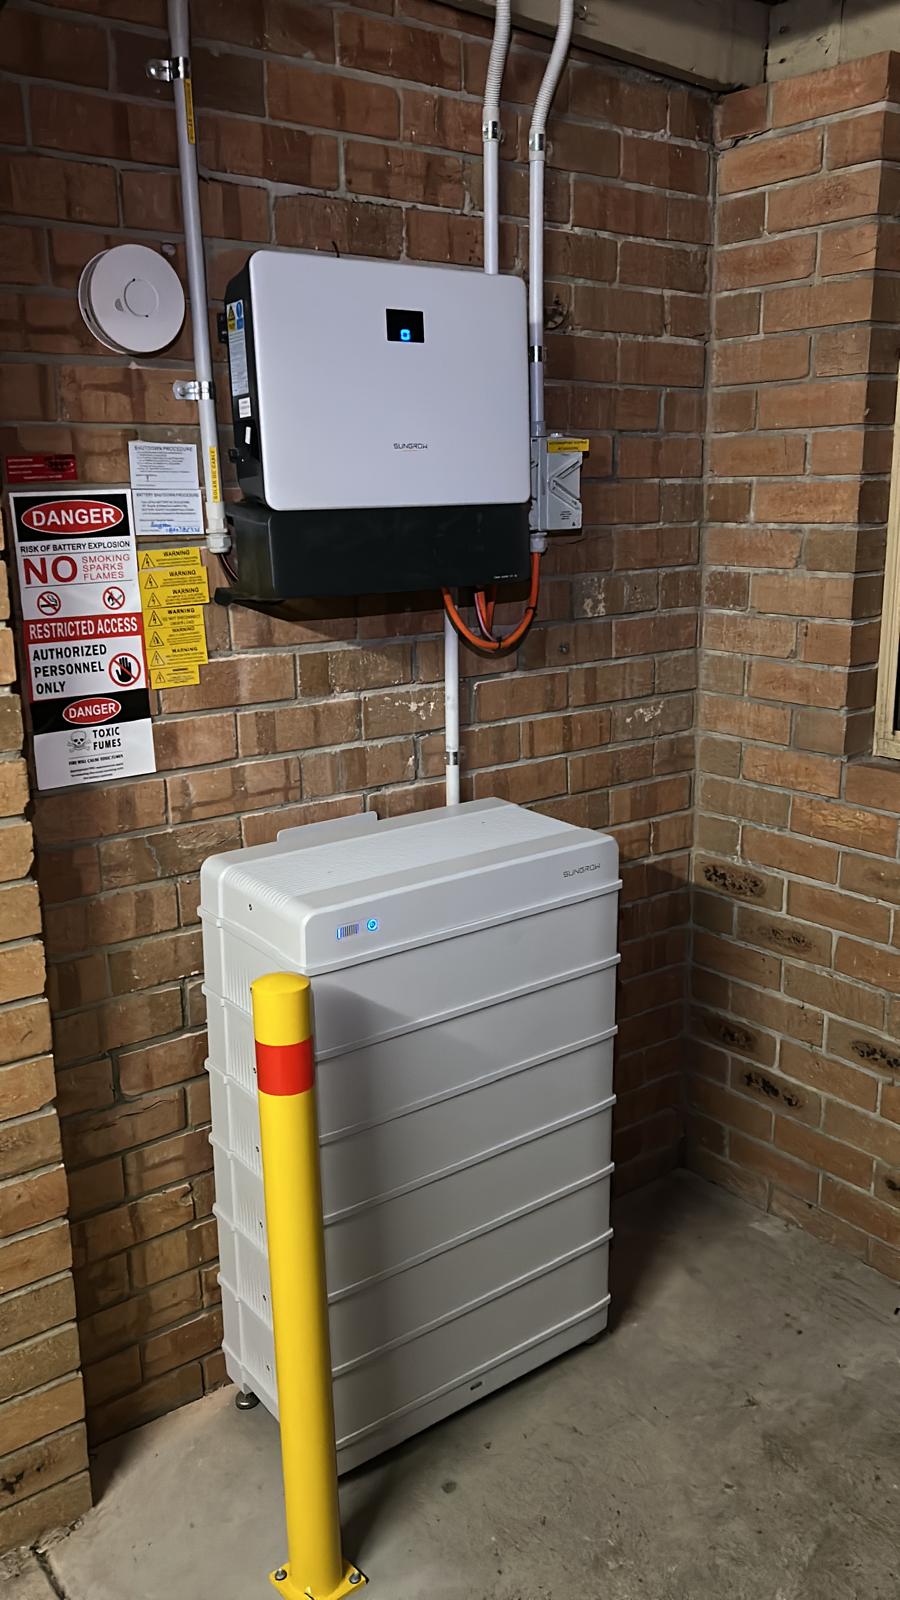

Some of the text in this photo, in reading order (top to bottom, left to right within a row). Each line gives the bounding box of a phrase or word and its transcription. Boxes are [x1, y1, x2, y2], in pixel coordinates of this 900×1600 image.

[31, 508, 115, 527] DANGER
[20, 540, 130, 553] RISK OF BATTERY EXPLOSION
[163, 549, 190, 557] WARNING
[81, 553, 130, 564] SMOKING
[23, 555, 78, 585] NO
[82, 562, 123, 572] SPARKS
[169, 569, 196, 577] WARNING
[83, 571, 124, 581] FLAMES
[29, 617, 138, 640] RESTRICTED ACCESS
[32, 644, 107, 662] AUTHORIZED
[34, 661, 105, 678] PERSONNEL
[36, 681, 66, 694] ONLY
[68, 703, 116, 719] DANGER
[93, 726, 120, 738] TOXIC
[93, 738, 121, 750] FUMES
[563, 863, 600, 878] SUNGROW
